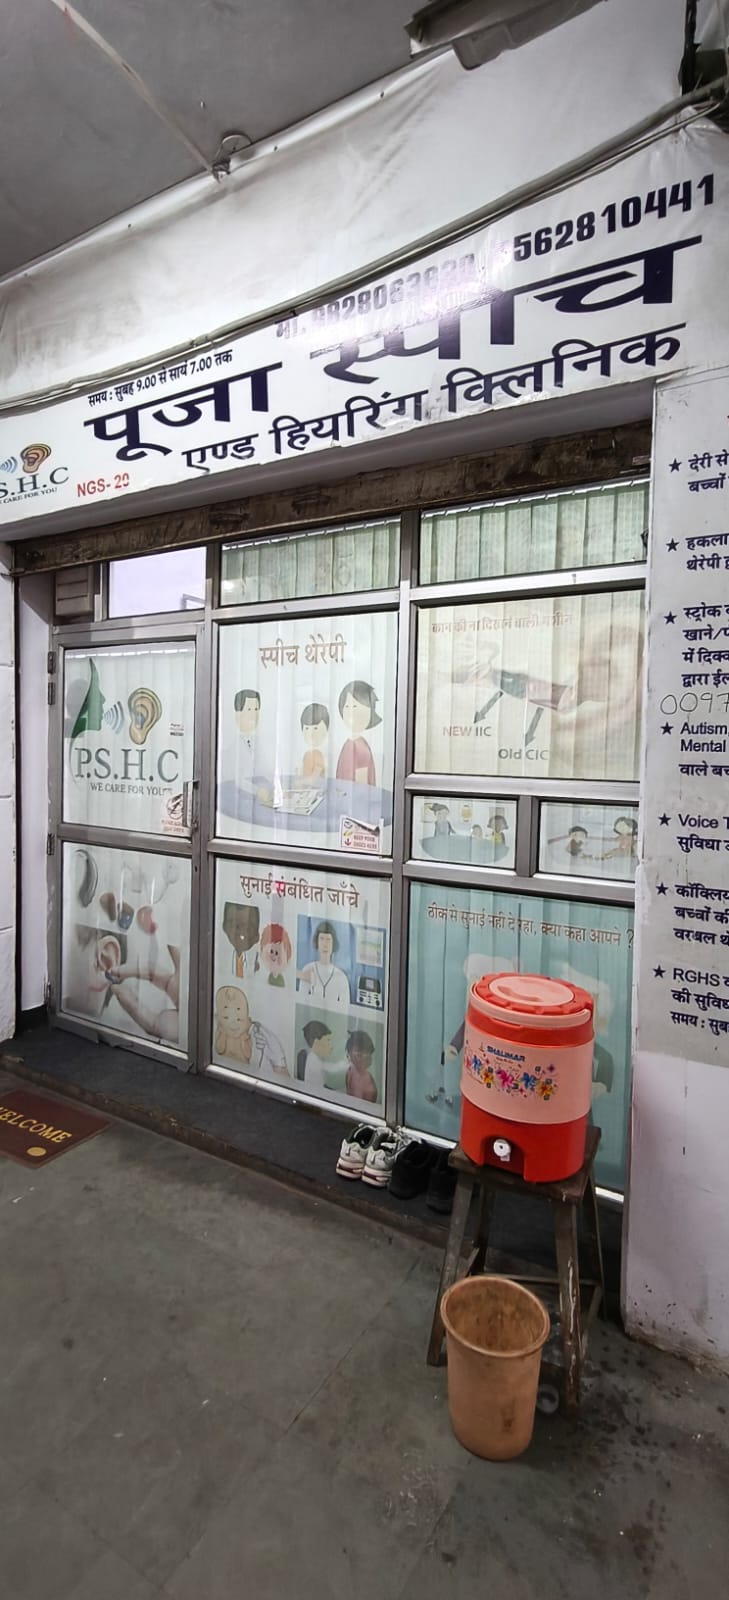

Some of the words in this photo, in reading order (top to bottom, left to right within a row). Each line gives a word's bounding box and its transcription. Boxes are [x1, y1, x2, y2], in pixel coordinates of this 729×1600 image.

[503, 173, 714, 263] 562810441
[88, 390, 107, 407] समय
[114, 381, 134, 401] सुबह
[136, 375, 156, 392] 9.00
[158, 366, 167, 384] से
[190, 357, 212, 375] 7.00
[213, 349, 233, 366] तक
[182, 433, 259, 473] एण्ड
[268, 391, 428, 455] हियरिंग
[441, 322, 686, 413] क्लिनिक
[83, 361, 283, 461] पूजा
[688, 452, 713, 472] देरी
[715, 449, 729, 467] से
[688, 472, 726, 492] बच्चों
[41, 487, 58, 496] YOU
[687, 553, 721, 571] थेरेपी
[683, 602, 722, 621] स्ट्रोक
[259, 638, 299, 669] स्पीच
[305, 633, 347, 664] थेरेपी
[682, 647, 695, 663] में
[681, 673, 710, 688] द्वारा
[443, 726, 471, 737] NEW
[475, 726, 492, 737] IIC
[498, 748, 522, 760] Old
[525, 748, 549, 761] CIC
[680, 738, 726, 753] Mental
[74, 747, 179, 783] P.S.H.C
[678, 760, 708, 776] वाले
[90, 782, 103, 791] WE
[104, 783, 126, 793] CARE
[127, 783, 144, 795] FOR
[678, 813, 719, 829] Voice
[676, 833, 721, 853] सुविधा
[240, 872, 273, 898] सुनाई
[275, 875, 324, 904] संबंधित
[674, 905, 711, 922] बच्चों
[428, 902, 447, 919] ठीक
[460, 908, 485, 929] सुनाई
[541, 921, 561, 937] क्या
[562, 925, 586, 942] कहा
[590, 926, 621, 945] आपने
[673, 967, 720, 987] RGHS
[671, 987, 692, 1004] की
[670, 1011, 698, 1027] समय
